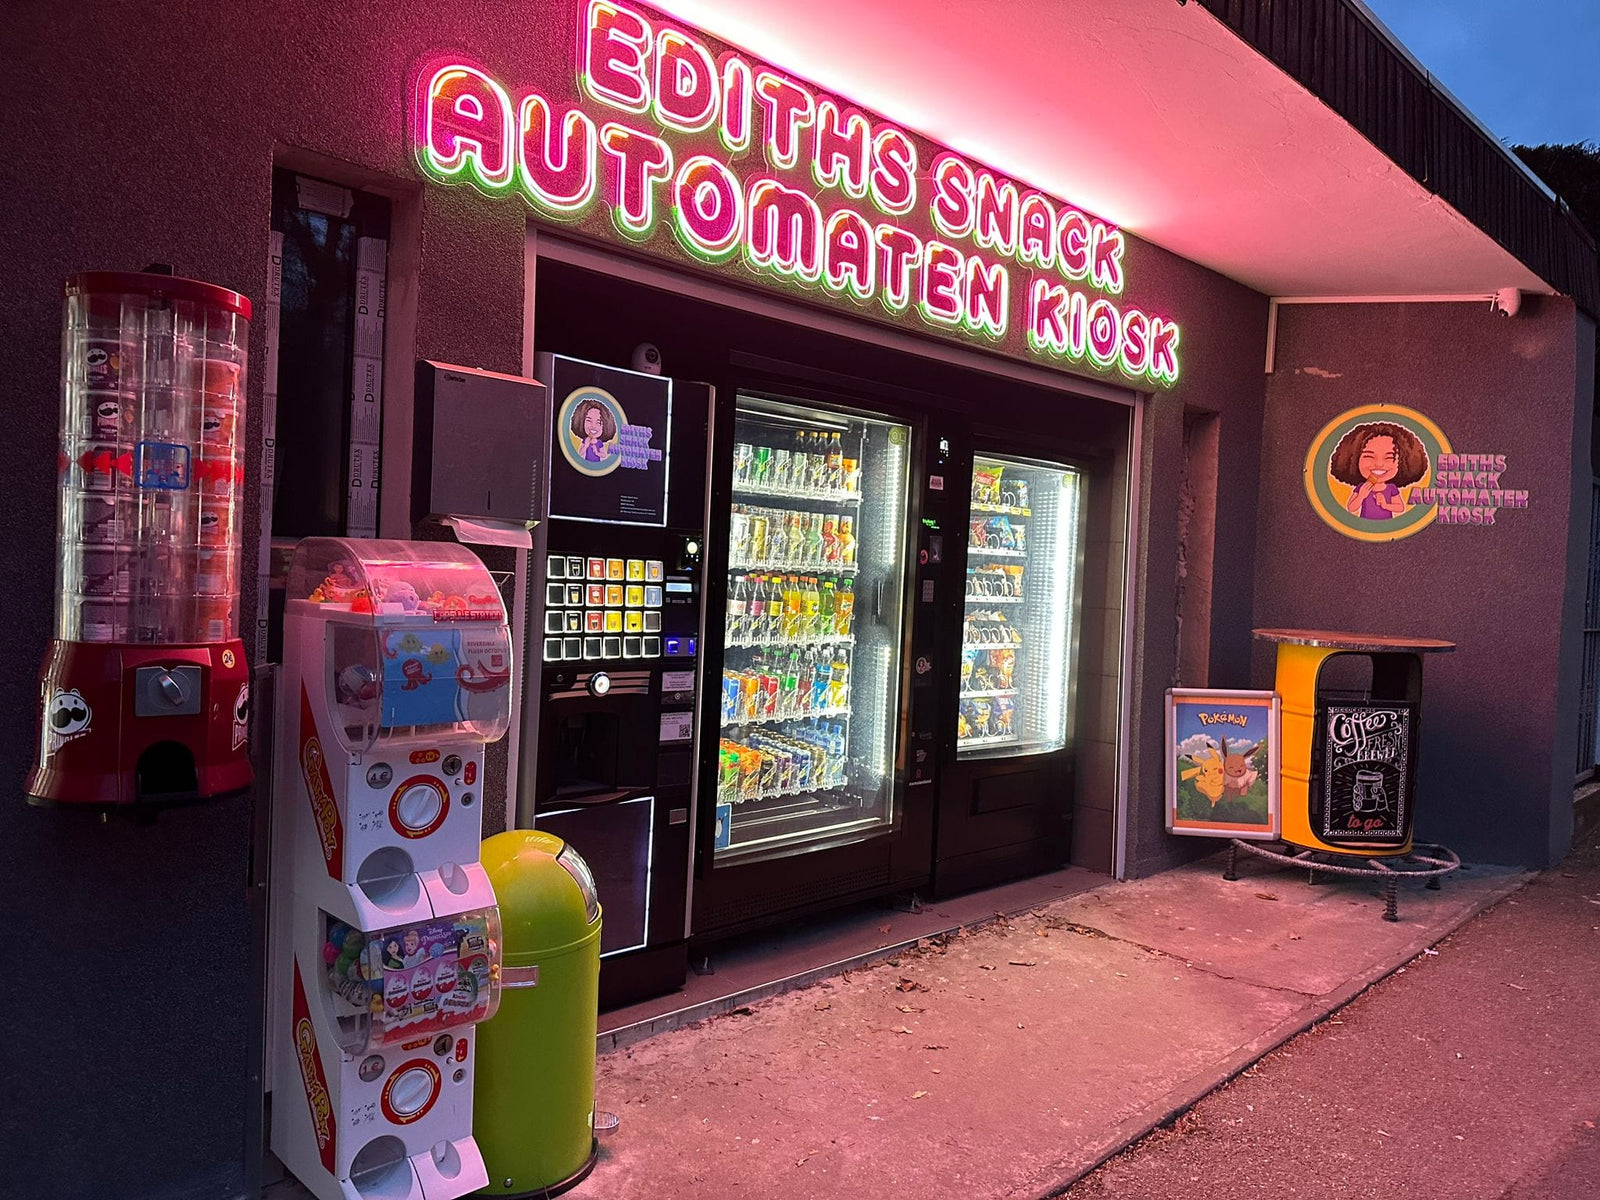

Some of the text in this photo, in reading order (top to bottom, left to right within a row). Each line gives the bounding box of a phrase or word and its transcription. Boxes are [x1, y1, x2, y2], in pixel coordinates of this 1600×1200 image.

[580, 0, 1125, 295] EDITHS SNACK
[420, 63, 1181, 384] AUTOMATEN KIOSK
[1437, 453, 1507, 473] EDITHS
[1436, 471, 1502, 489] SNACK
[1408, 487, 1529, 509] AUTOMATEN
[1438, 506, 1498, 526] KIOSK
[1330, 711, 1397, 757] Coffee
[1347, 814, 1384, 831] to go
